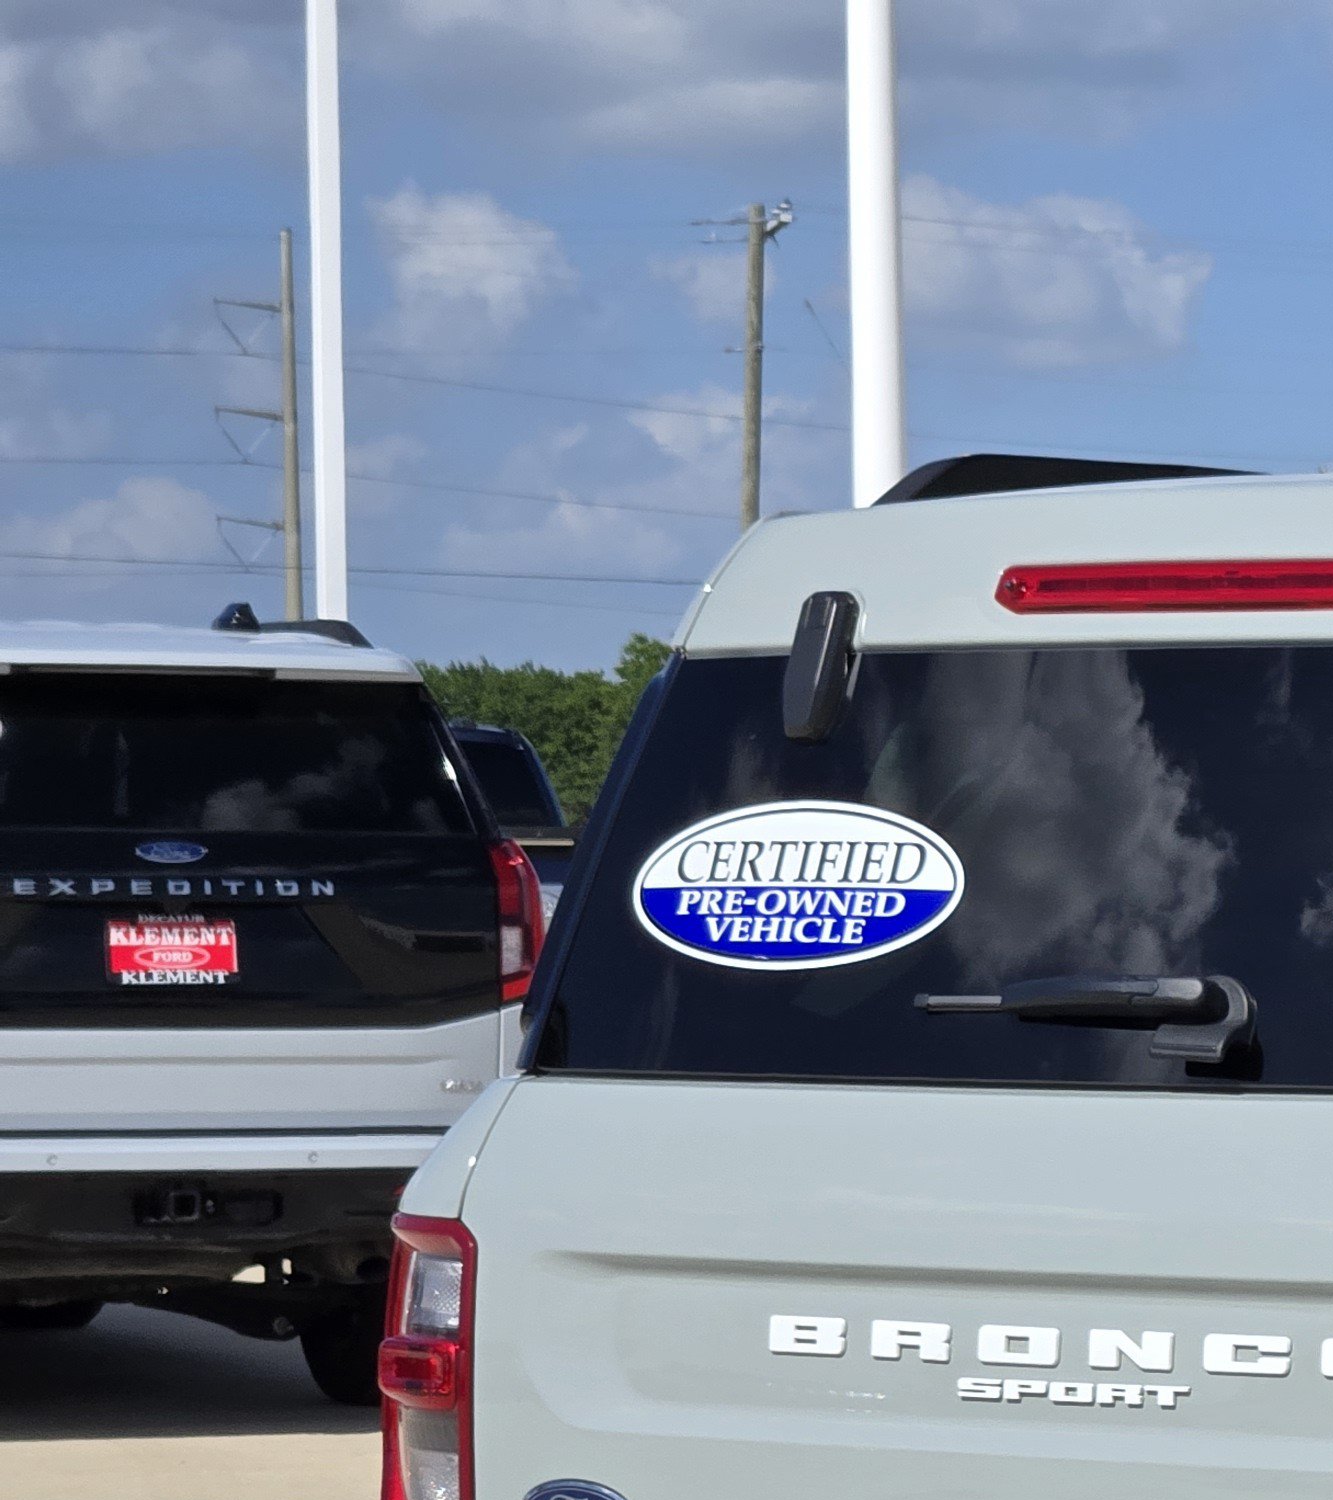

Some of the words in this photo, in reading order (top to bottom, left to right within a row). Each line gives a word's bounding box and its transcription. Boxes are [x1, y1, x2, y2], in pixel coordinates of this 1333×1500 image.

[676, 840, 927, 884] CERTIFIED
[13, 878, 335, 896] EXPEDITION
[675, 889, 906, 918] PRE-OWNED
[109, 927, 234, 946] KLEMENT
[704, 916, 867, 944] VEHICLE
[151, 951, 194, 963] FORD
[120, 969, 229, 985] KLEMENT
[956, 1376, 1192, 1409] SPORT
